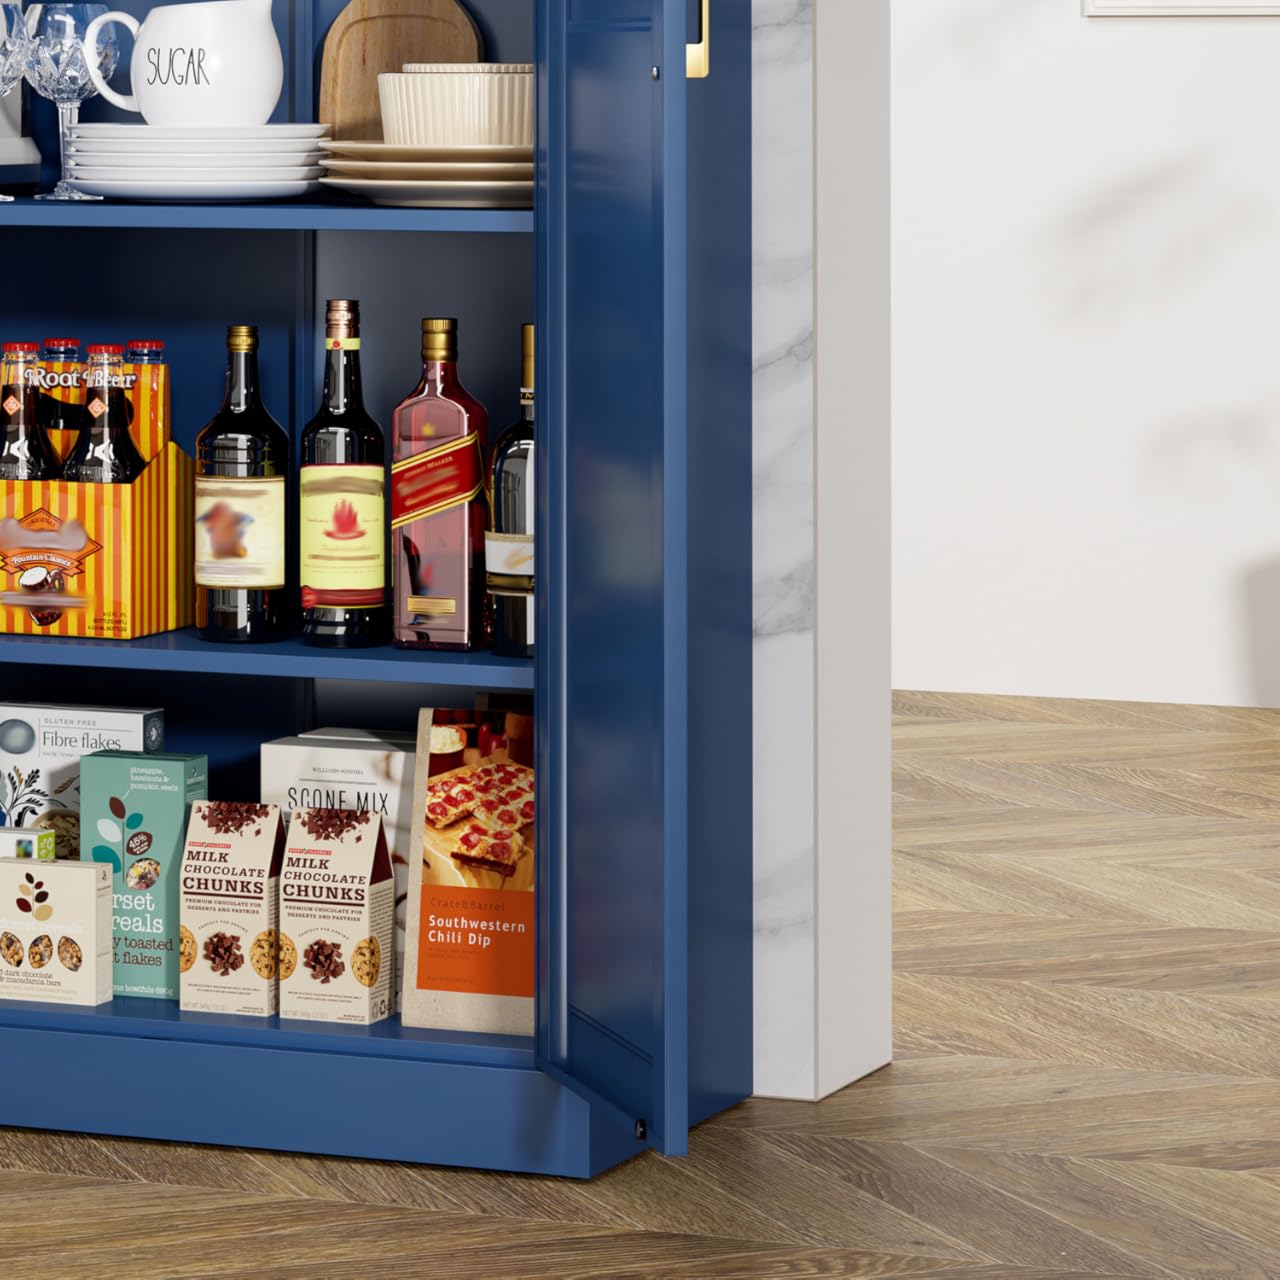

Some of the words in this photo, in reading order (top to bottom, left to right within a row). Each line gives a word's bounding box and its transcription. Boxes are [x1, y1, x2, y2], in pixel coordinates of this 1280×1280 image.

[147, 48, 210, 85] SUGAR
[11, 554, 43, 565] Fountain
[43, 731, 77, 747] Fibre
[82, 733, 121, 750] flakes
[288, 787, 347, 810] SCONE
[357, 792, 388, 816] MIX
[186, 850, 229, 863] MILK
[286, 857, 330, 870] MILK
[184, 864, 265, 878] CHOCOLATE
[284, 871, 367, 885] CHOCOLATE
[183, 877, 264, 894] CHUNKS
[283, 884, 365, 901] CHUNKS
[428, 915, 526, 933] Southwestern
[124, 937, 174, 951] toasted
[428, 930, 462, 944] Chili
[468, 933, 491, 949] Dip
[123, 952, 162, 966] flakes
